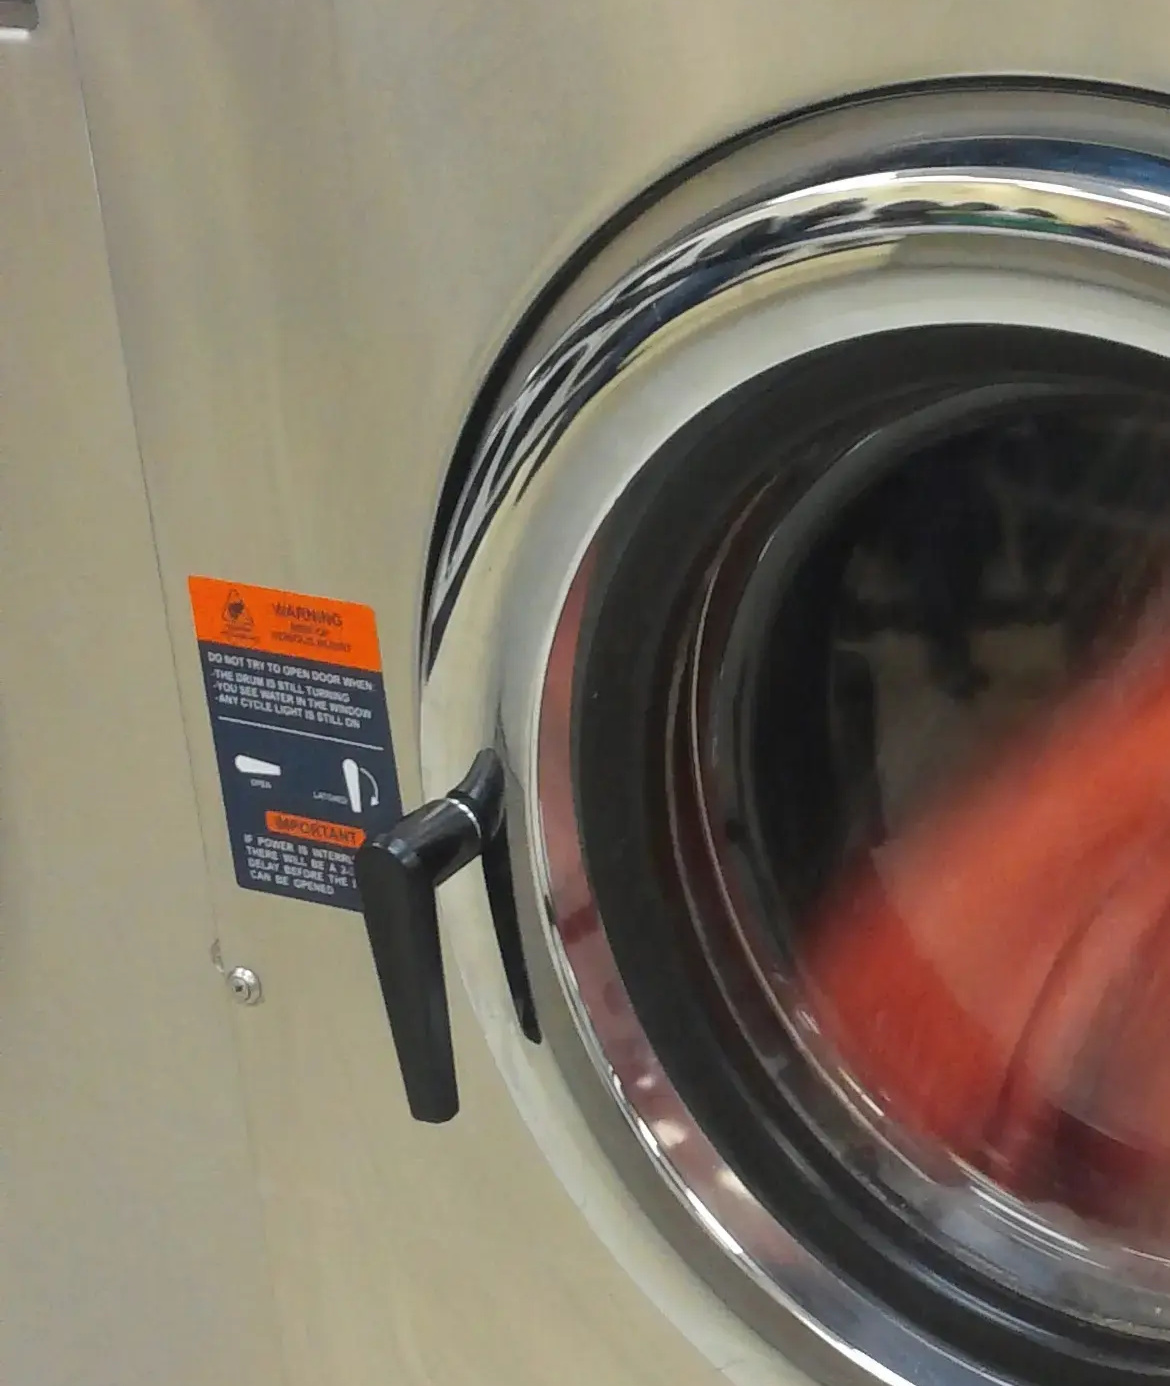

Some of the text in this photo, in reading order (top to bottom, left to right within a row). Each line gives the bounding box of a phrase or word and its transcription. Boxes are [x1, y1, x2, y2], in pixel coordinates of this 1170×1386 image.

[272, 601, 343, 627] WARNING
[207, 651, 222, 663] DO
[224, 655, 244, 667] NOT
[246, 658, 265, 671] TRY
[266, 662, 281, 673] TO
[282, 665, 310, 680] OPEN
[311, 670, 341, 685] DOOR
[240, 697, 273, 712] CYCLE
[307, 697, 328, 711] THE
[275, 814, 356, 846] IMPORTANT
[257, 836, 294, 852] POWER
[250, 869, 271, 881] CAN
[329, 863, 337, 873] A
[326, 873, 349, 887] THE
